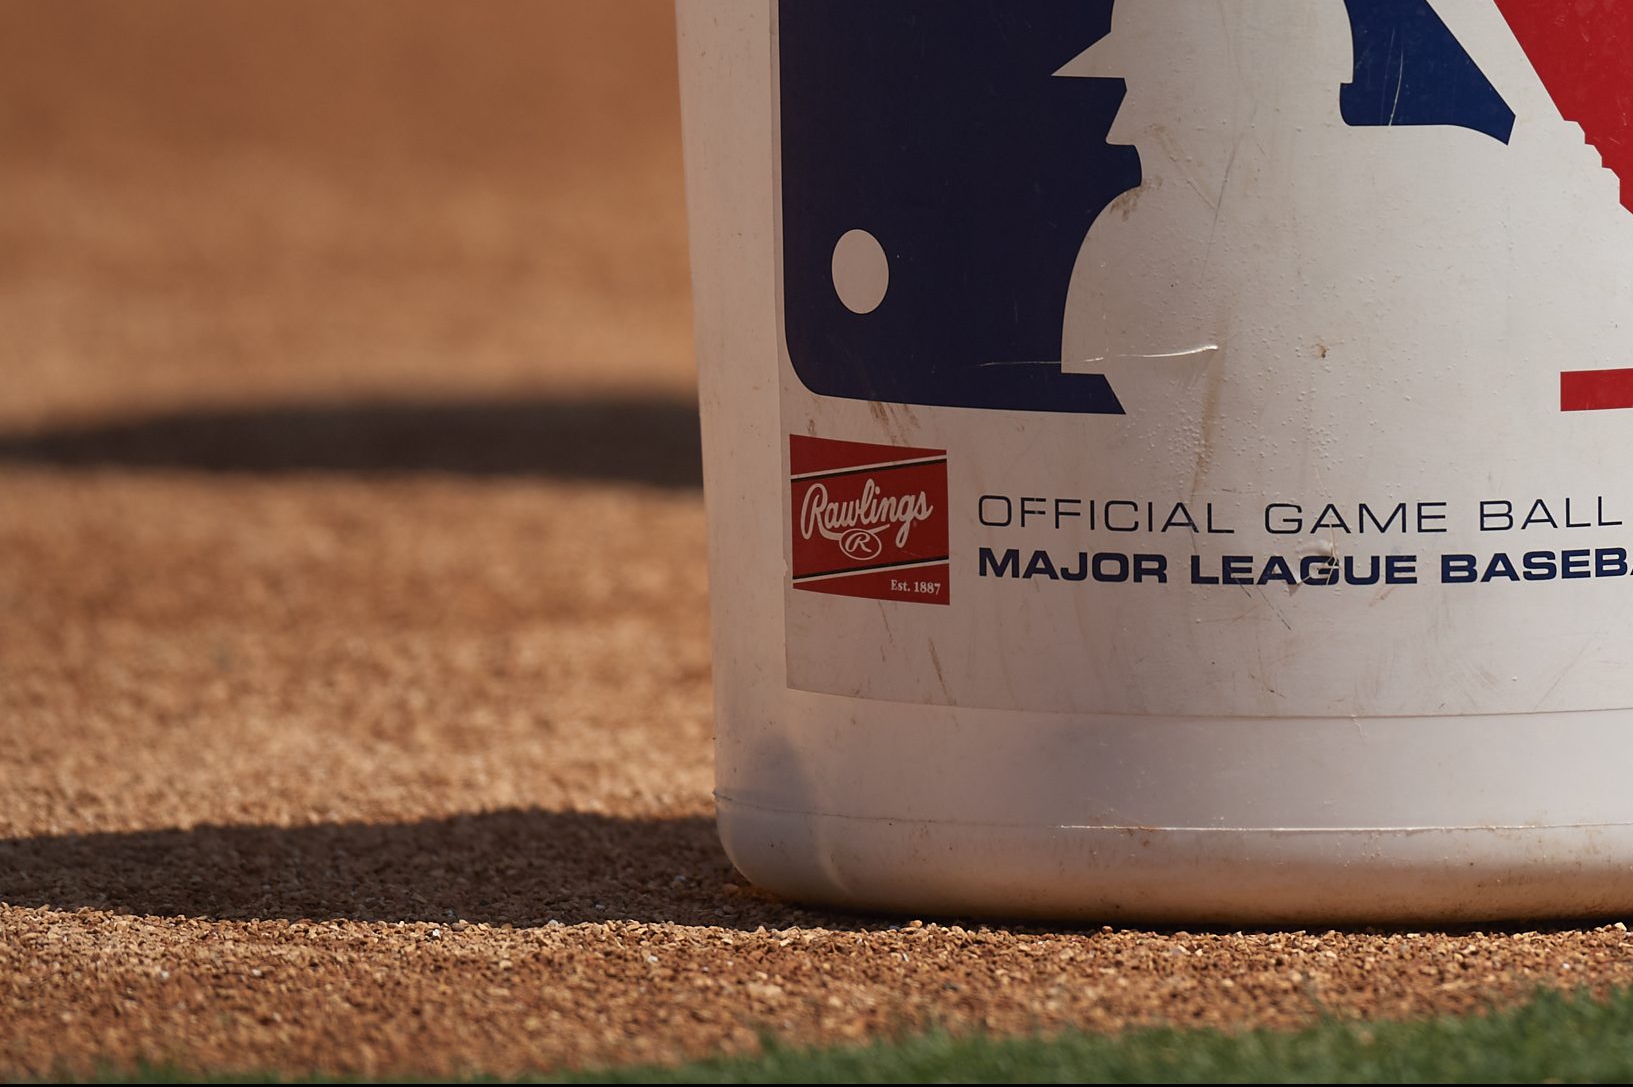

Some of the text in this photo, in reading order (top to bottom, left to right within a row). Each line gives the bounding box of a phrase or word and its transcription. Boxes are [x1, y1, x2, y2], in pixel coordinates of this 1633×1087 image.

[801, 478, 933, 548] Rawlings
[978, 495, 1235, 534] OFFICIAL
[1264, 501, 1448, 535] GAME
[1479, 495, 1623, 532] BALL
[978, 547, 1168, 583] MAJOR
[1190, 554, 1418, 585] LEAGUE
[890, 578, 941, 595] Est. 1887
